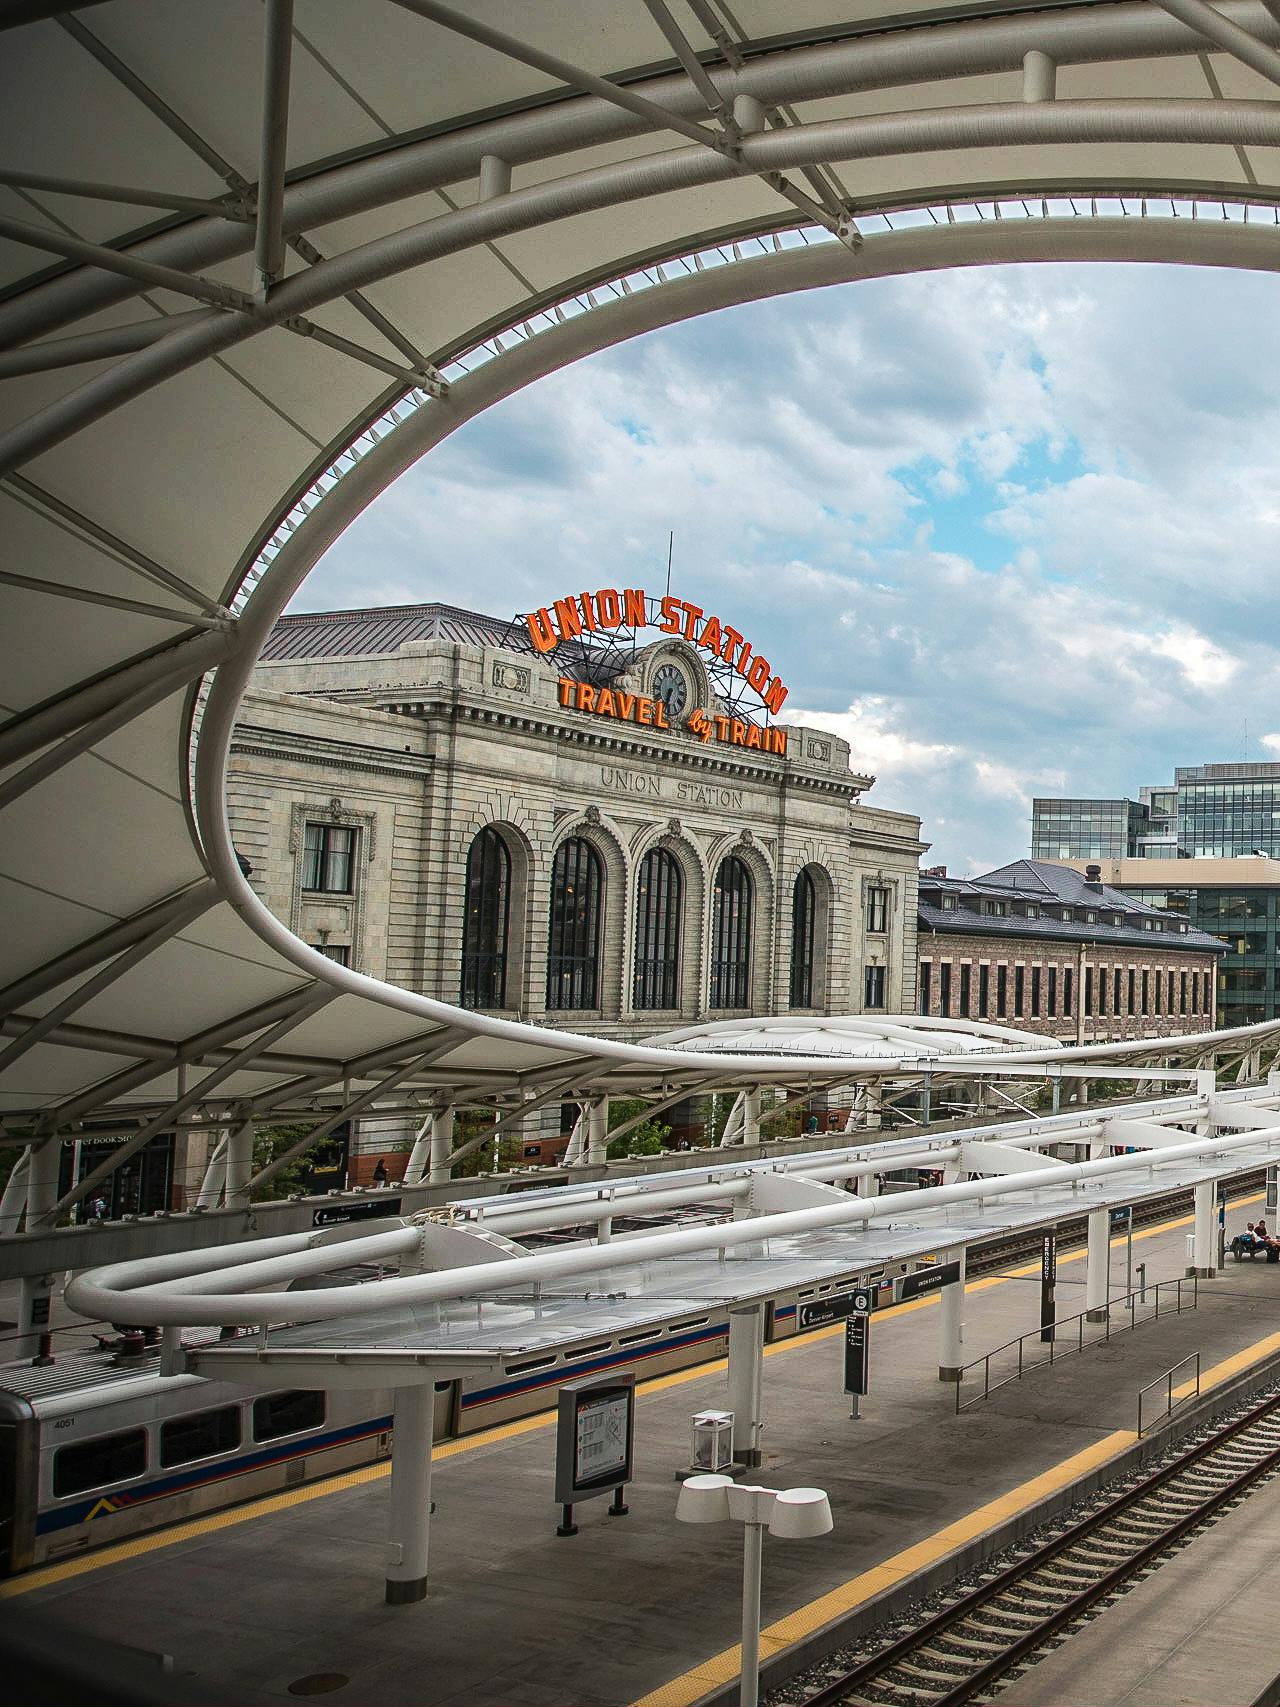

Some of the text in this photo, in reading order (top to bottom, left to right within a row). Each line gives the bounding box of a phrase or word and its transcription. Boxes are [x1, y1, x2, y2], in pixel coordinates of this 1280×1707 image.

[526, 588, 789, 716] UNION STATION
[558, 677, 788, 755] TRAVEL by TRAIN
[601, 767, 745, 809] UNION STATION
[54, 1417, 75, 1429] 4051
